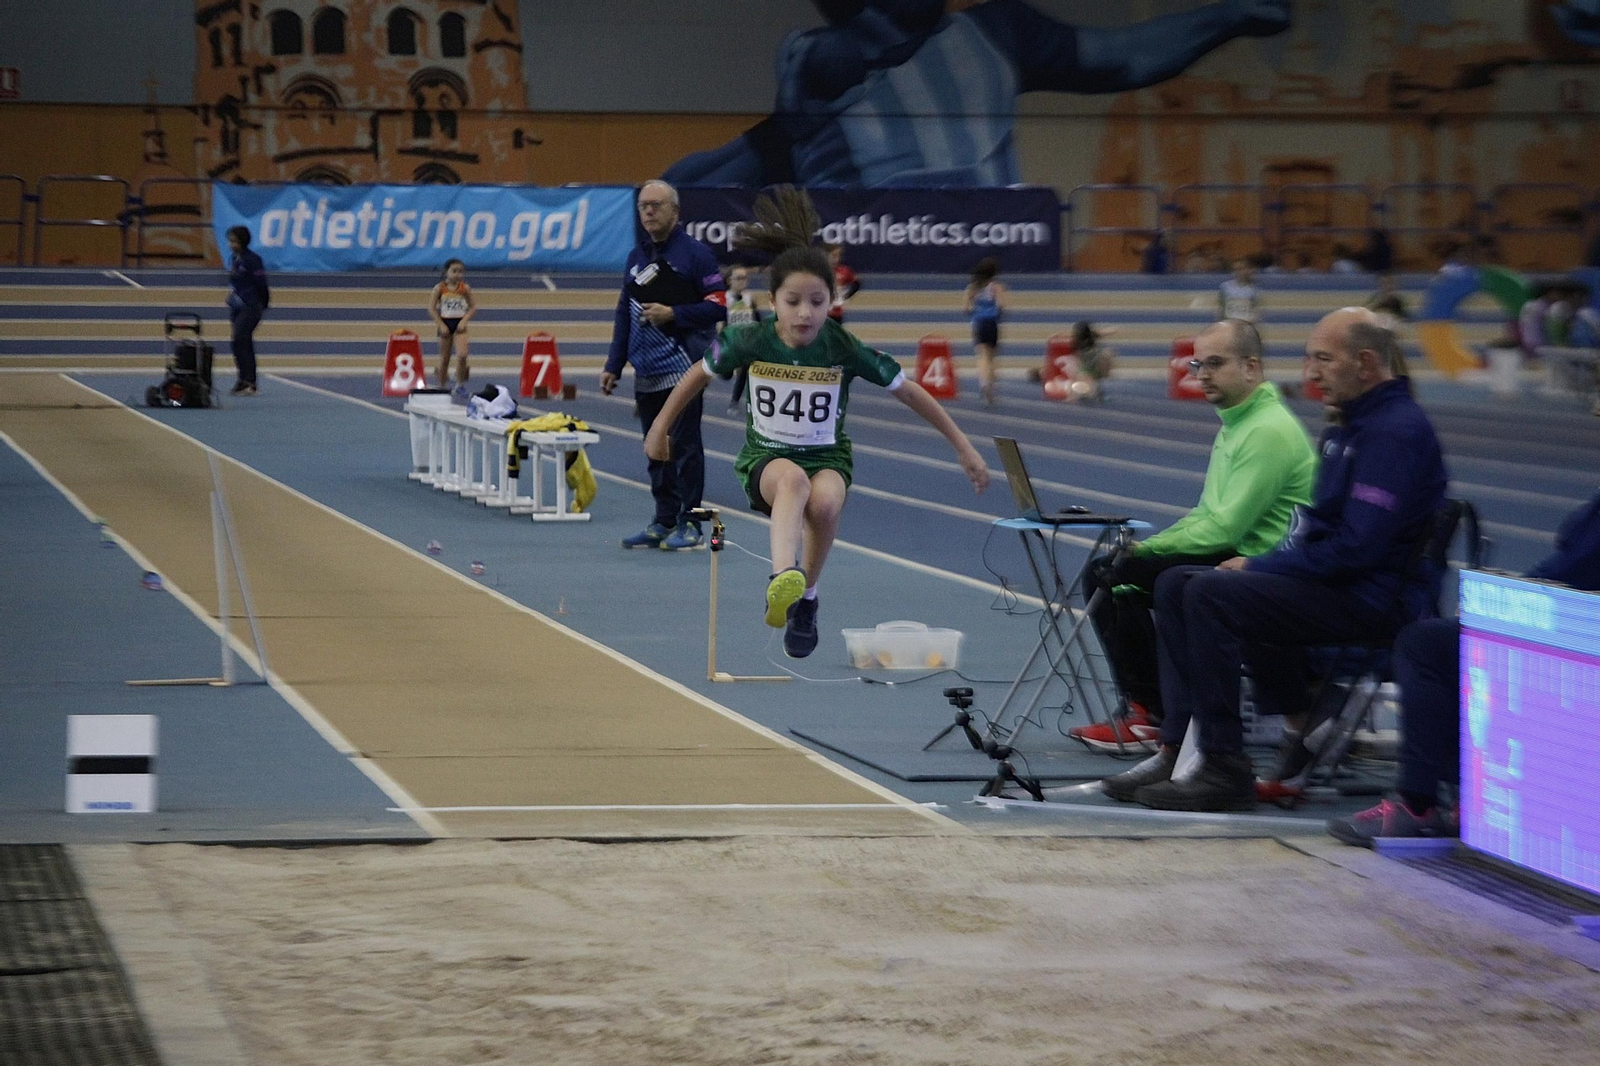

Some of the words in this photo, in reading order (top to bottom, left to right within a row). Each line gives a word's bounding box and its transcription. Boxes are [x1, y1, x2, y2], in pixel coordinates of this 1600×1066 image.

[259, 197, 589, 260] atletismo.gal
[392, 353, 416, 391] 8
[531, 355, 552, 387] 7
[808, 371, 839, 382] 2025
[922, 356, 947, 388] 4
[755, 385, 832, 423] 848
